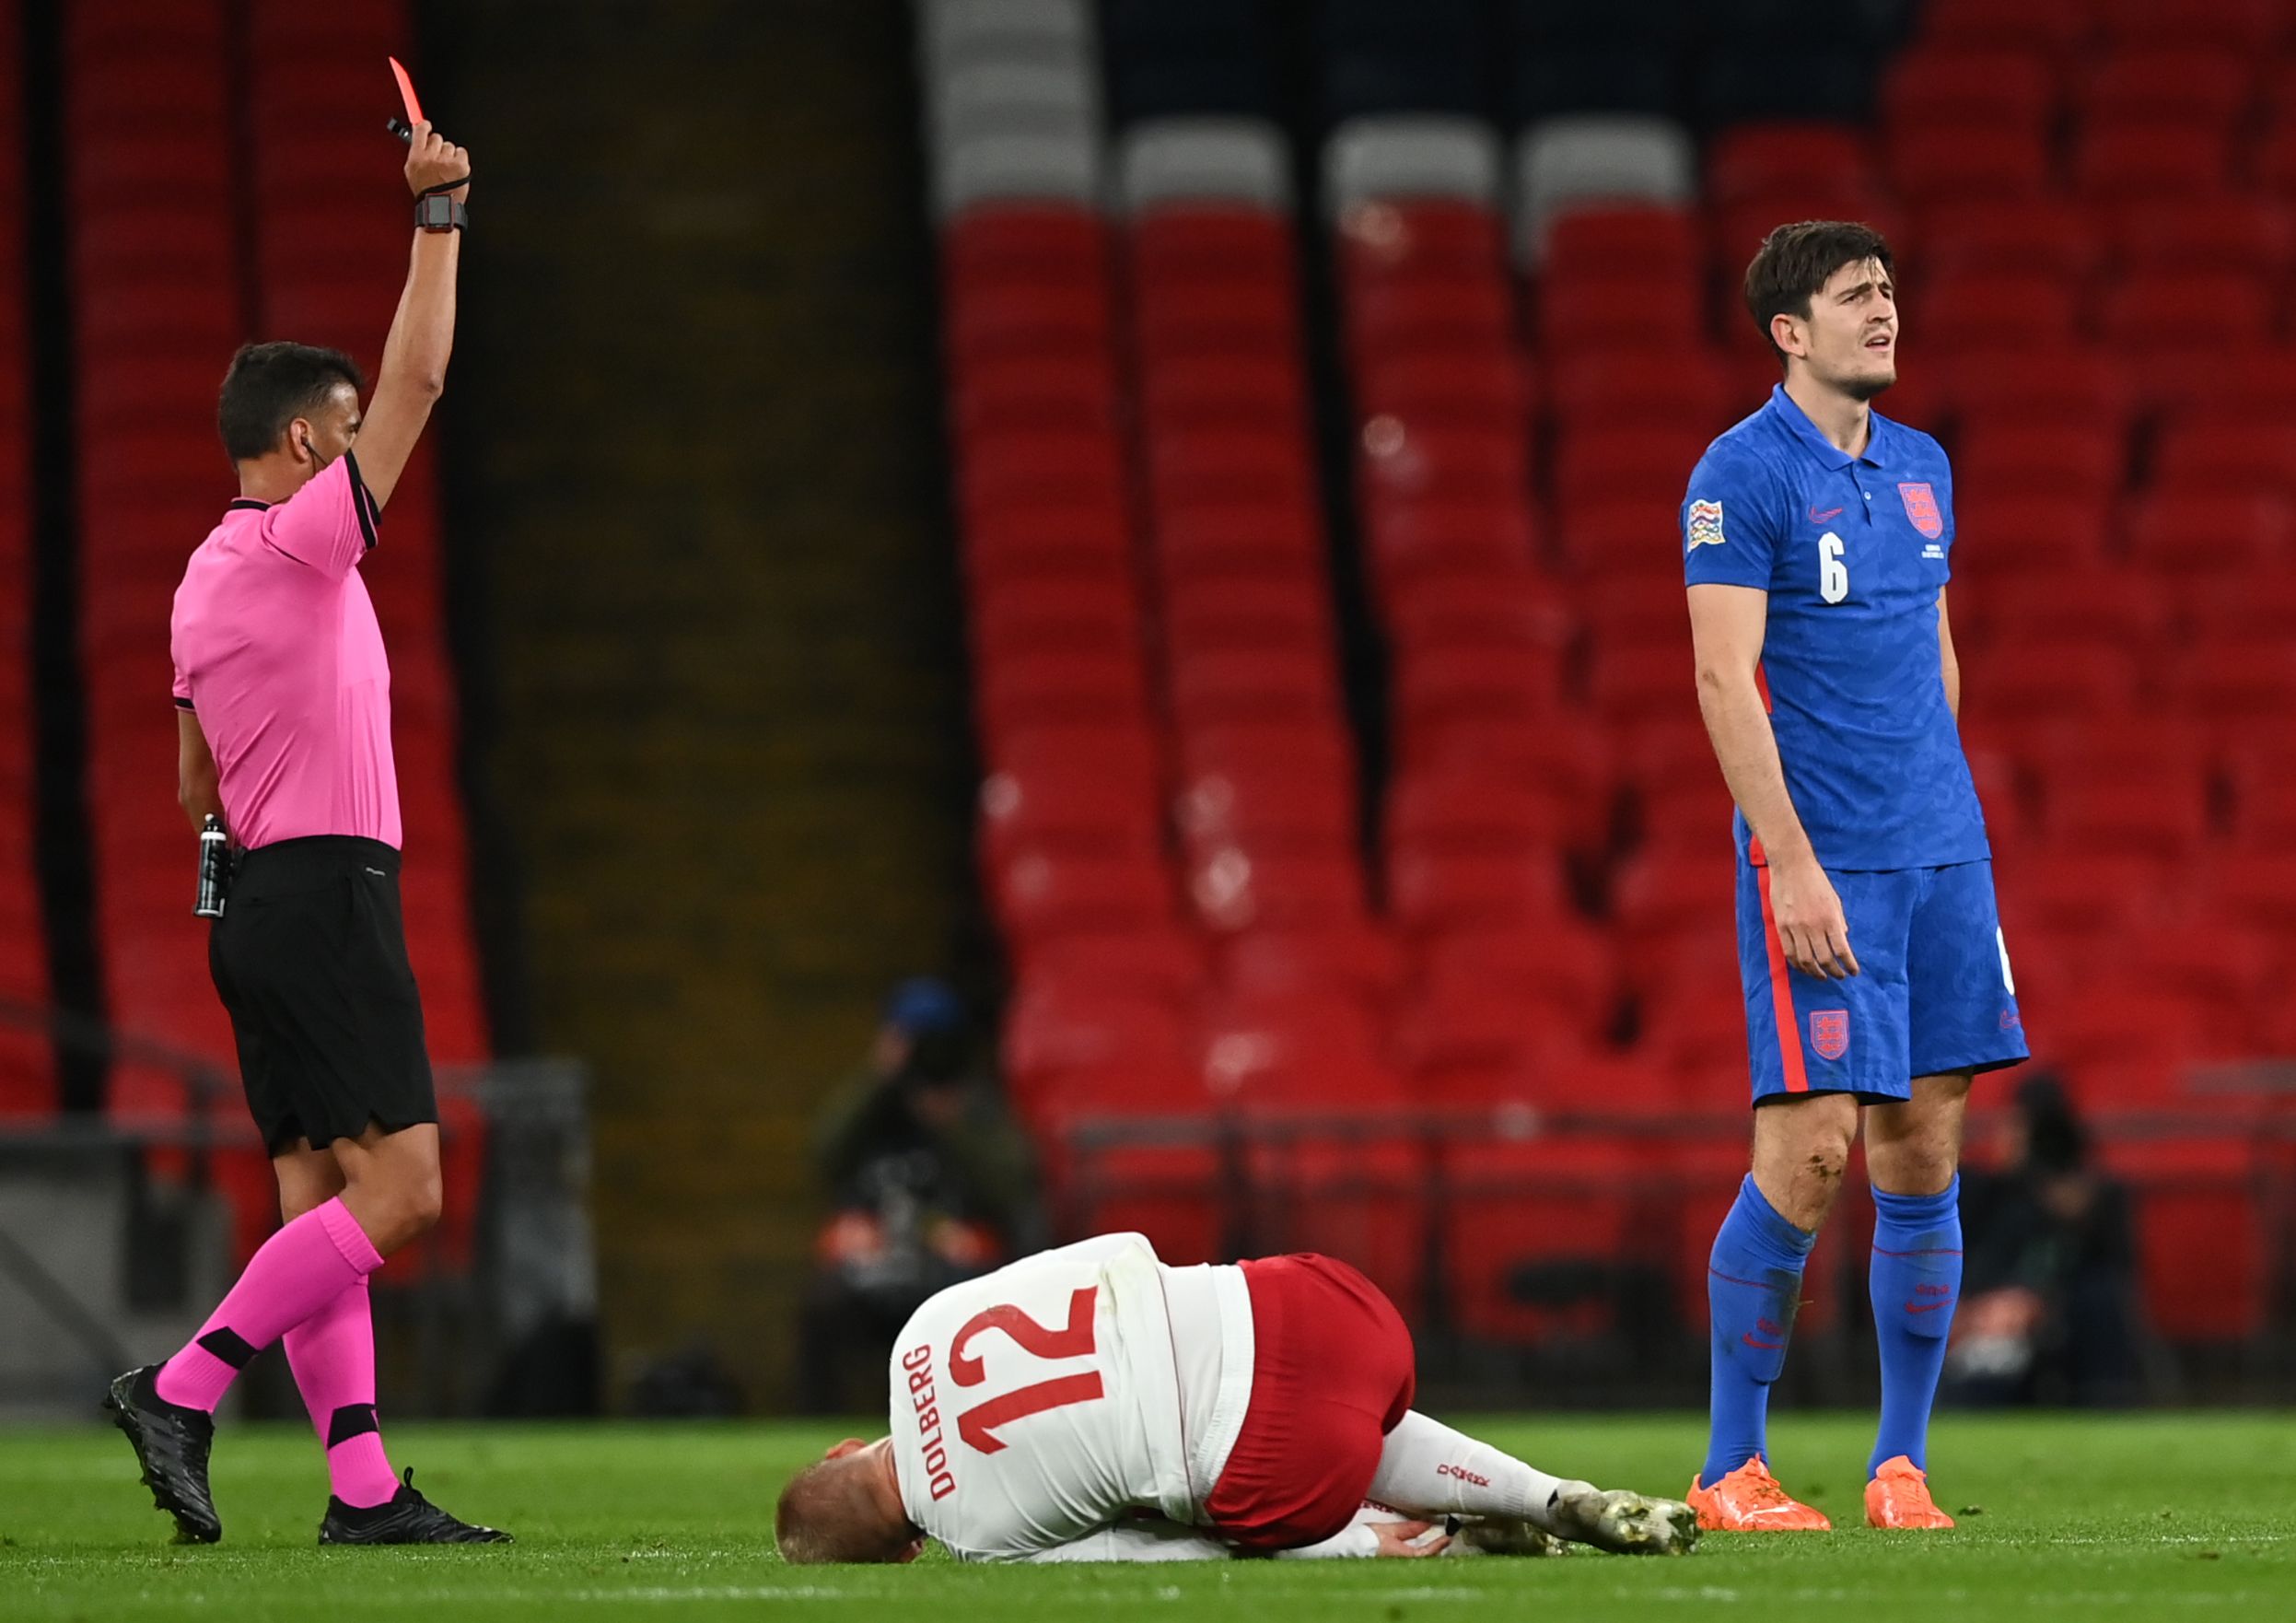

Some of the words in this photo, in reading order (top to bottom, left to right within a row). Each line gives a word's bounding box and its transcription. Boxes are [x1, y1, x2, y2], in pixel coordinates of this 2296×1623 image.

[1818, 531, 1848, 603] 6
[903, 1344, 956, 1501] DOLBERG
[949, 1285, 1104, 1455] 12
